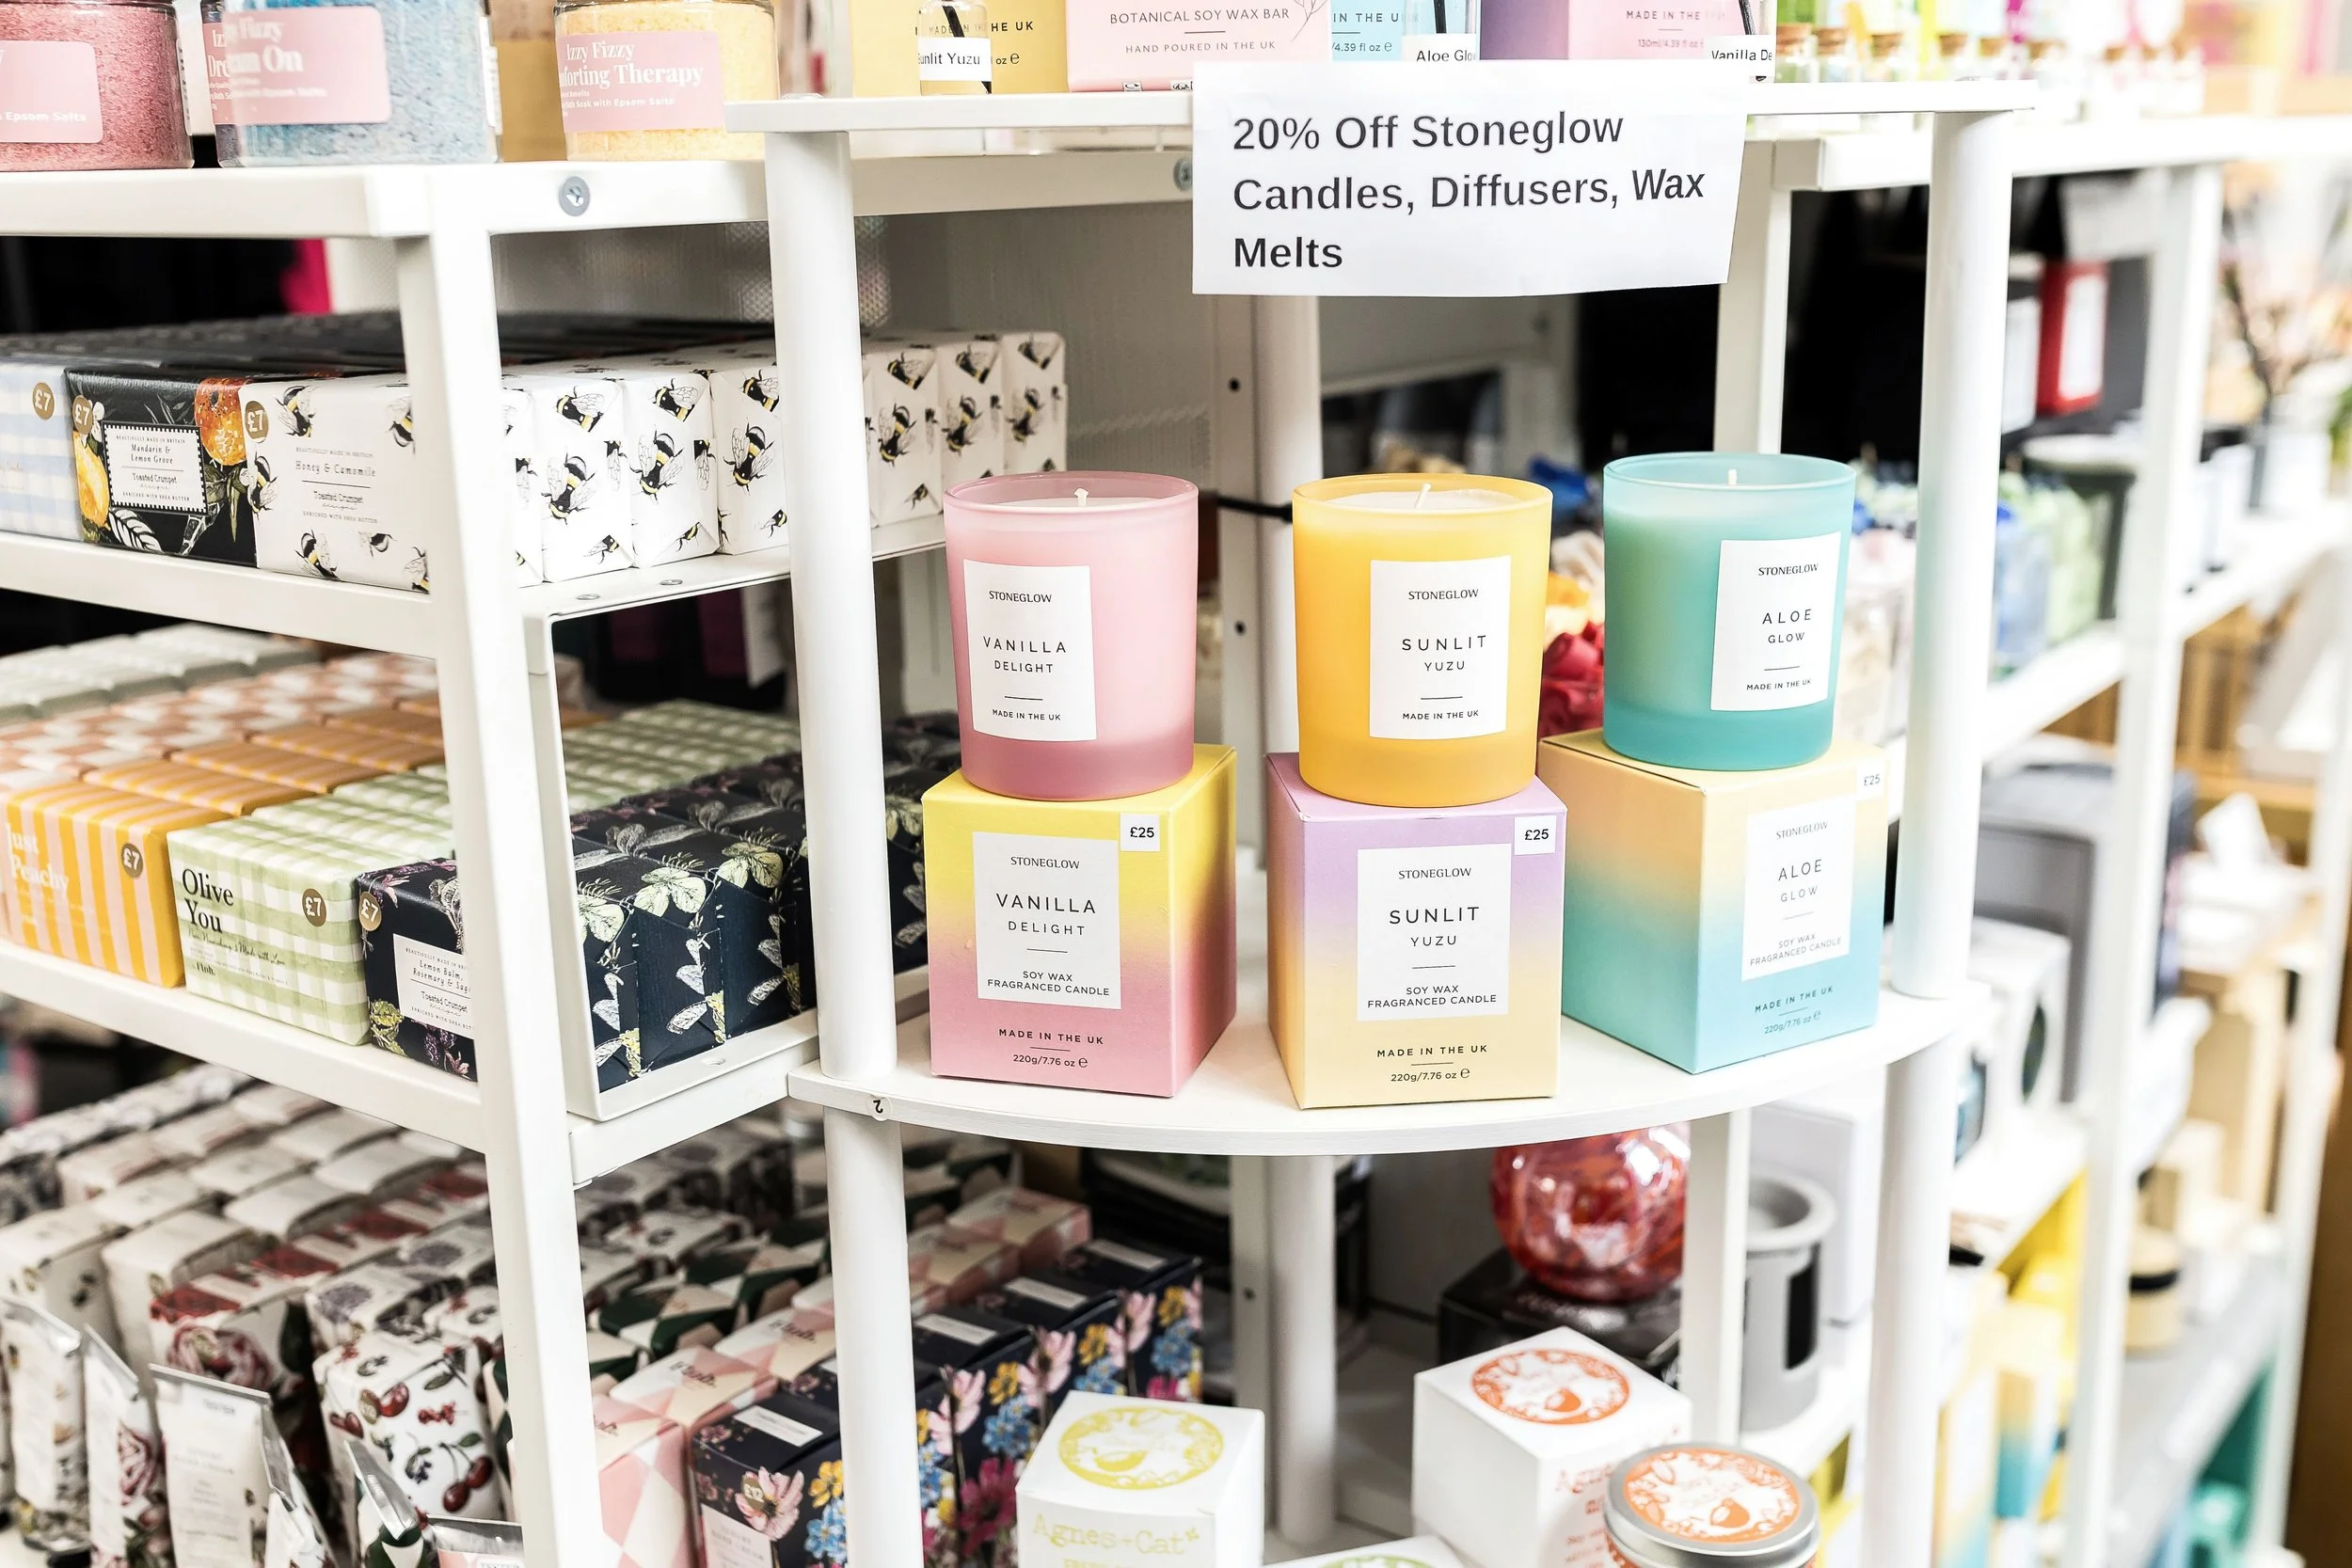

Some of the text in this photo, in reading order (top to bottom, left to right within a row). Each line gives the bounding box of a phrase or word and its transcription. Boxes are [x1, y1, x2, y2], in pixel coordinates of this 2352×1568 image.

[1110, 7, 1290, 24] BOTANICAL SOY WAX BAR
[1333, 12, 1383, 23] IN THE
[1626, 10, 1658, 20] MADE
[1663, 11, 1675, 20] IN
[1680, 11, 1701, 21] THE
[1016, 21, 1034, 31] UK
[566, 40, 635, 63] Izzy Fizzy
[1125, 40, 1276, 54] HAND POURED IN THE UK
[1359, 42, 1366, 52] fl
[946, 52, 980, 65] Yuzu
[1416, 50, 1450, 62] Aloe
[1711, 50, 1756, 61] Vanilla
[613, 62, 704, 87] Therapy
[613, 98, 646, 108] Epsom
[6, 111, 87, 123] Epsom Salts
[1233, 110, 1625, 154] 20% Off Stoneglow
[1232, 167, 1706, 216] Candles, Diffusers, Wax
[1233, 235, 1343, 270] Melts
[35, 388, 52, 412] £7
[74, 404, 90, 426] £7
[247, 409, 263, 433] £7
[131, 443, 163, 454] Mandarin
[131, 453, 173, 465] Lemon Grove
[1758, 562, 1819, 577] STONEGLOW
[989, 590, 1053, 604] STONEGLOW
[1408, 588, 1479, 601] STONEGLOW
[1762, 609, 1812, 626] ALOE
[982, 635, 1067, 654] VANILLA
[1401, 634, 1487, 652] SUNLIT
[1767, 631, 1805, 644] GLOW
[993, 659, 1055, 673] DELIGHT
[1423, 659, 1466, 672] YUZU
[1746, 677, 1812, 691] MADE IN THE UK
[992, 708, 1061, 721] MADE IN THE UK
[1402, 709, 1479, 721] MADE IN THE UK
[5, 822, 40, 854] Just
[1129, 826, 1155, 839] £25
[1524, 828, 1549, 841] £25
[1775, 821, 1829, 841] STONEGLOW
[123, 847, 140, 871] £7
[1010, 855, 1080, 870] STONEGLOW
[11, 853, 70, 897] Peachy
[1398, 866, 1472, 880] STONEGLOW
[1778, 858, 1823, 882] ALOE
[182, 868, 234, 907] Olive
[1780, 885, 1819, 904] GLOW
[305, 896, 322, 917] £7
[360, 898, 379, 923] £7
[995, 893, 1096, 914] VANILLA
[183, 897, 223, 934] You
[1389, 906, 1480, 926] SUNLIT
[1008, 920, 1086, 937] DELIGHT
[1409, 935, 1457, 948] YUZU
[1778, 933, 1817, 950] SOY WAX
[1750, 946, 1807, 967] FRAGRANCED
[413, 967, 445, 987] Rosemary
[420, 959, 464, 981] Lemon Balm,
[1022, 970, 1073, 983] SOY WAX
[987, 978, 1110, 997] FRAGRANCED CANDLE
[1406, 985, 1459, 996] SOY WAX
[1367, 994, 1497, 1009] FRAGRANCED CANDLE
[1755, 986, 1834, 1014] MADE IN THE UK
[998, 1028, 1104, 1045] MADE IN THE UK
[1376, 1044, 1488, 1058] MADE IN THE UK
[1012, 1053, 1076, 1068] 220g/7.76 oz
[1390, 1070, 1457, 1083] 220g/7.76 oz
